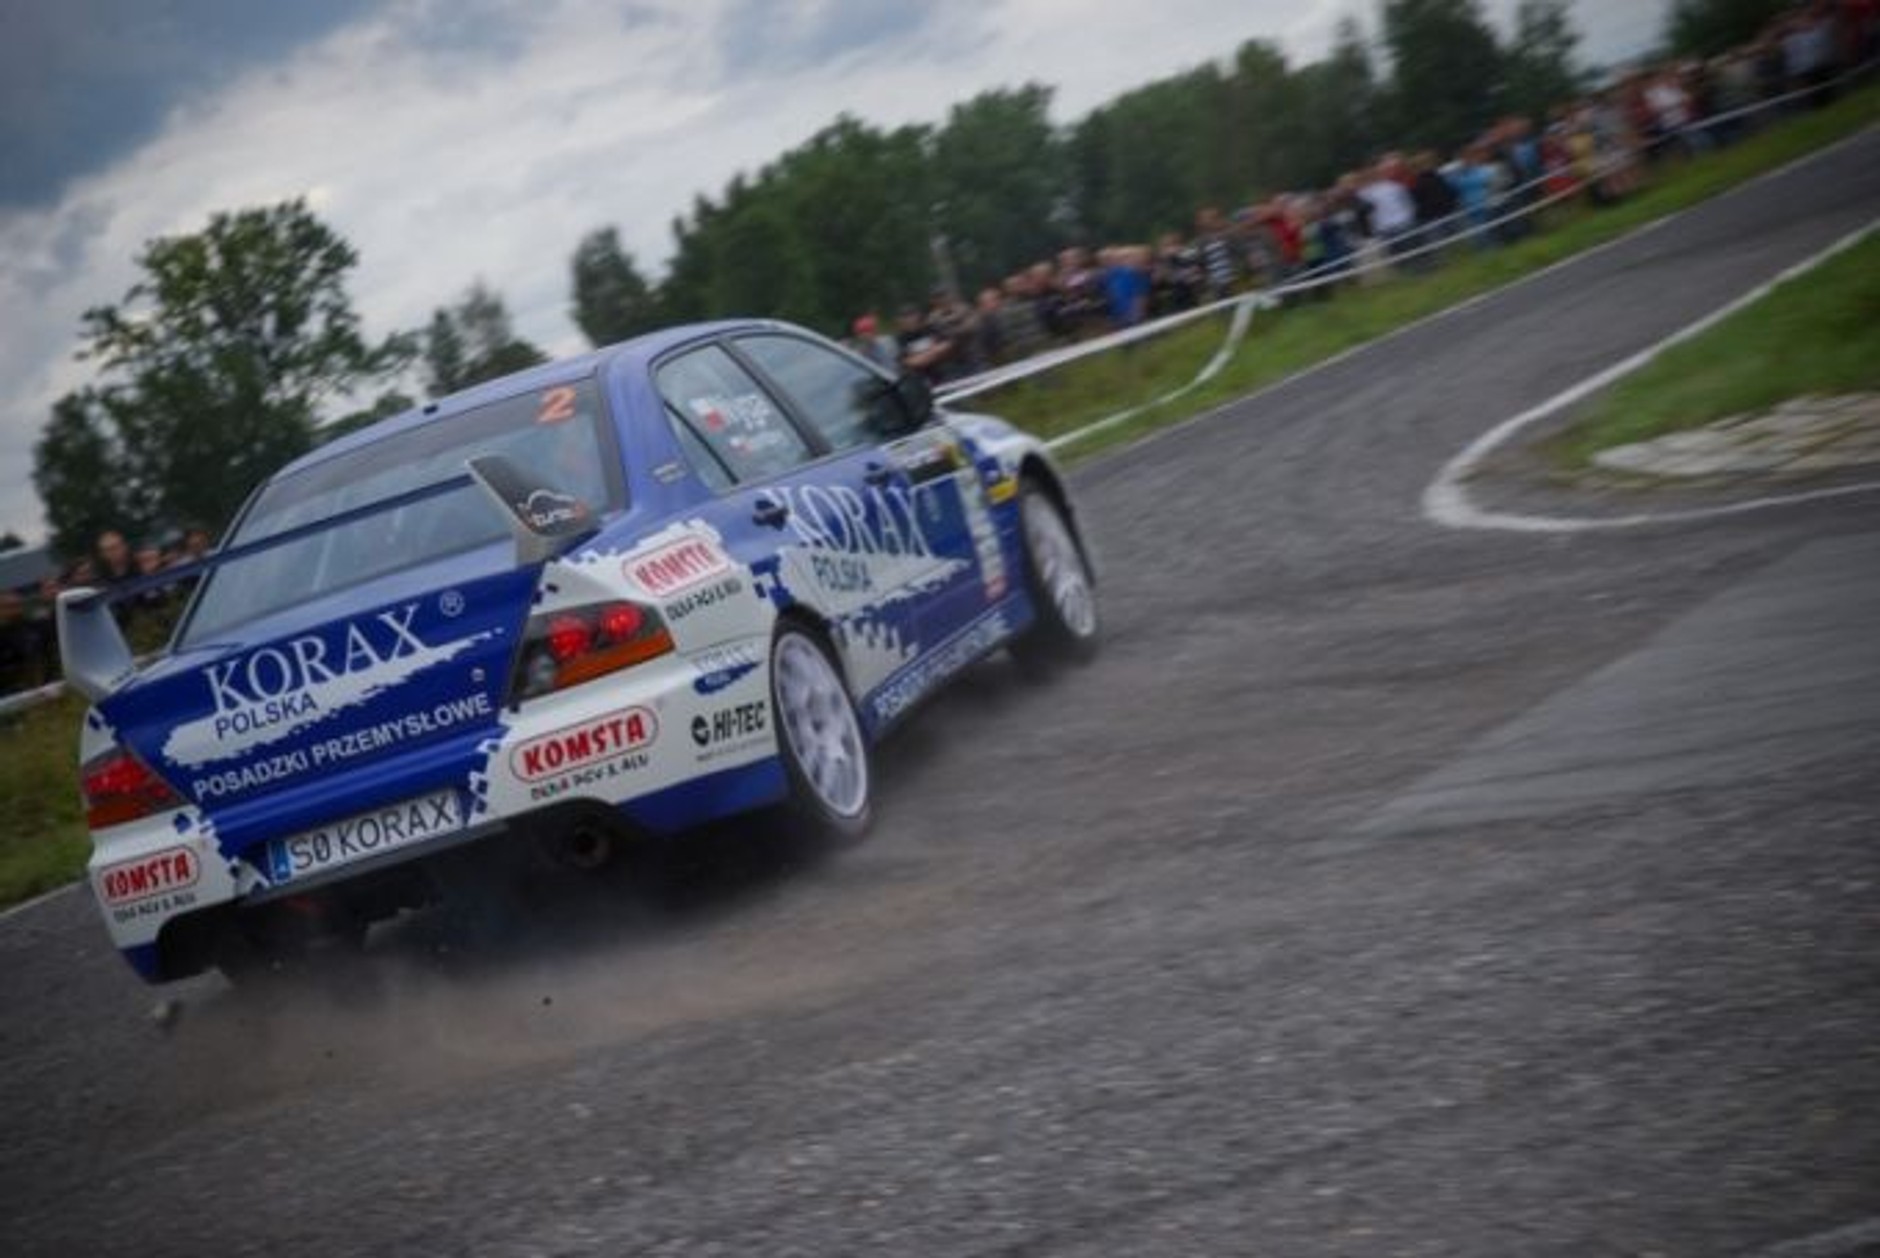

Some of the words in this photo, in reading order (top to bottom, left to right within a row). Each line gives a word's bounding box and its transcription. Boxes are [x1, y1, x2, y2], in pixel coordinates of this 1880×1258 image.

[537, 386, 576, 423] 2
[756, 485, 934, 559] KORAX
[205, 603, 428, 715] KORAX
[215, 692, 318, 740] POLSKA
[523, 713, 646, 776] KOMSTA
[713, 701, 765, 743] HI-TEC
[193, 750, 309, 801] POSADZKI
[313, 693, 493, 765] PRZEMYSŁOWE
[337, 796, 455, 856] KORAX
[104, 851, 191, 898] KOMSTA
